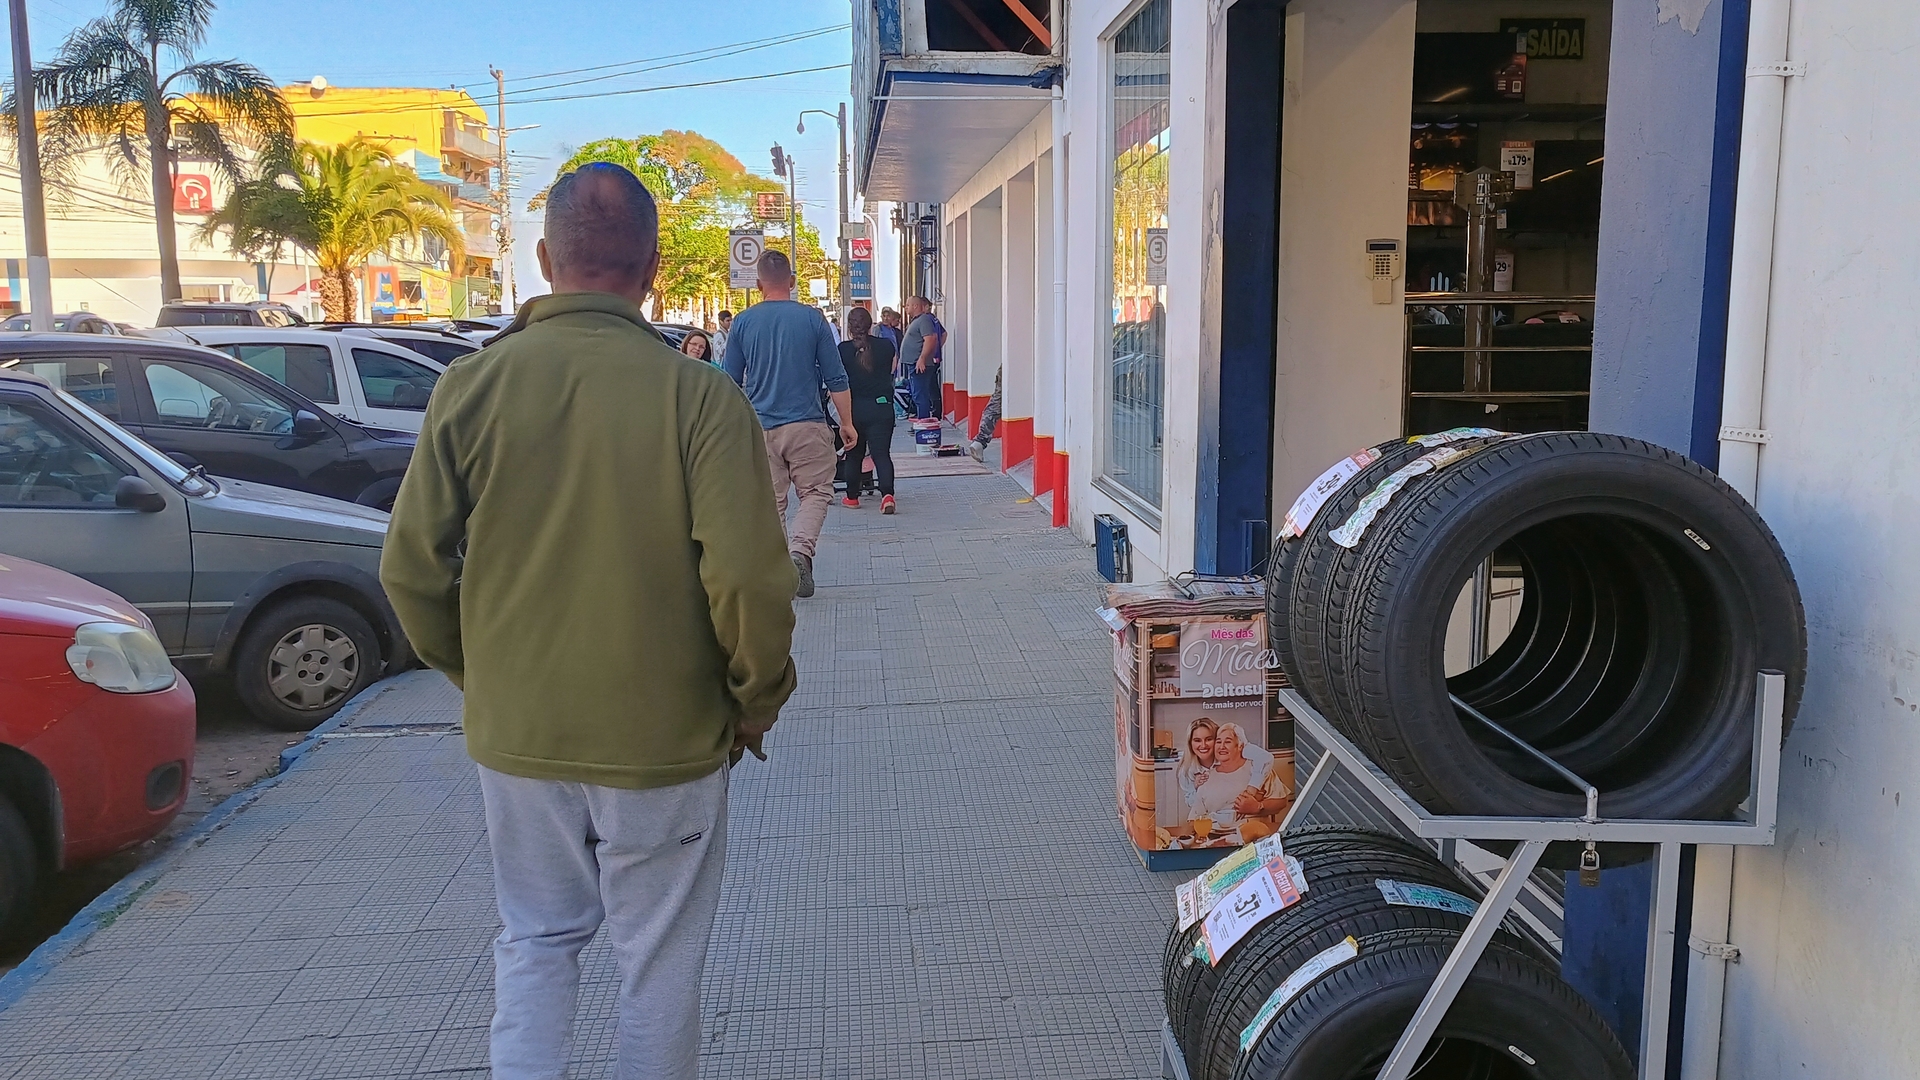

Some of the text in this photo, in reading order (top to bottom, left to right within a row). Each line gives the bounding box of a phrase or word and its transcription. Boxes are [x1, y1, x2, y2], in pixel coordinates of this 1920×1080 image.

[1527, 21, 1581, 57] SAÍDA
[1512, 155, 1527, 166] 179
[741, 243, 752, 260] E
[1211, 628, 1254, 639] Mês das
[1181, 639, 1280, 676] Mães
[1201, 681, 1266, 698] Deltasul
[1202, 701, 1214, 710] faz
[1215, 700, 1234, 709] mais
[1235, 701, 1248, 709] por
[1273, 869, 1294, 895] OFERTA
[1234, 893, 1261, 919] 37
